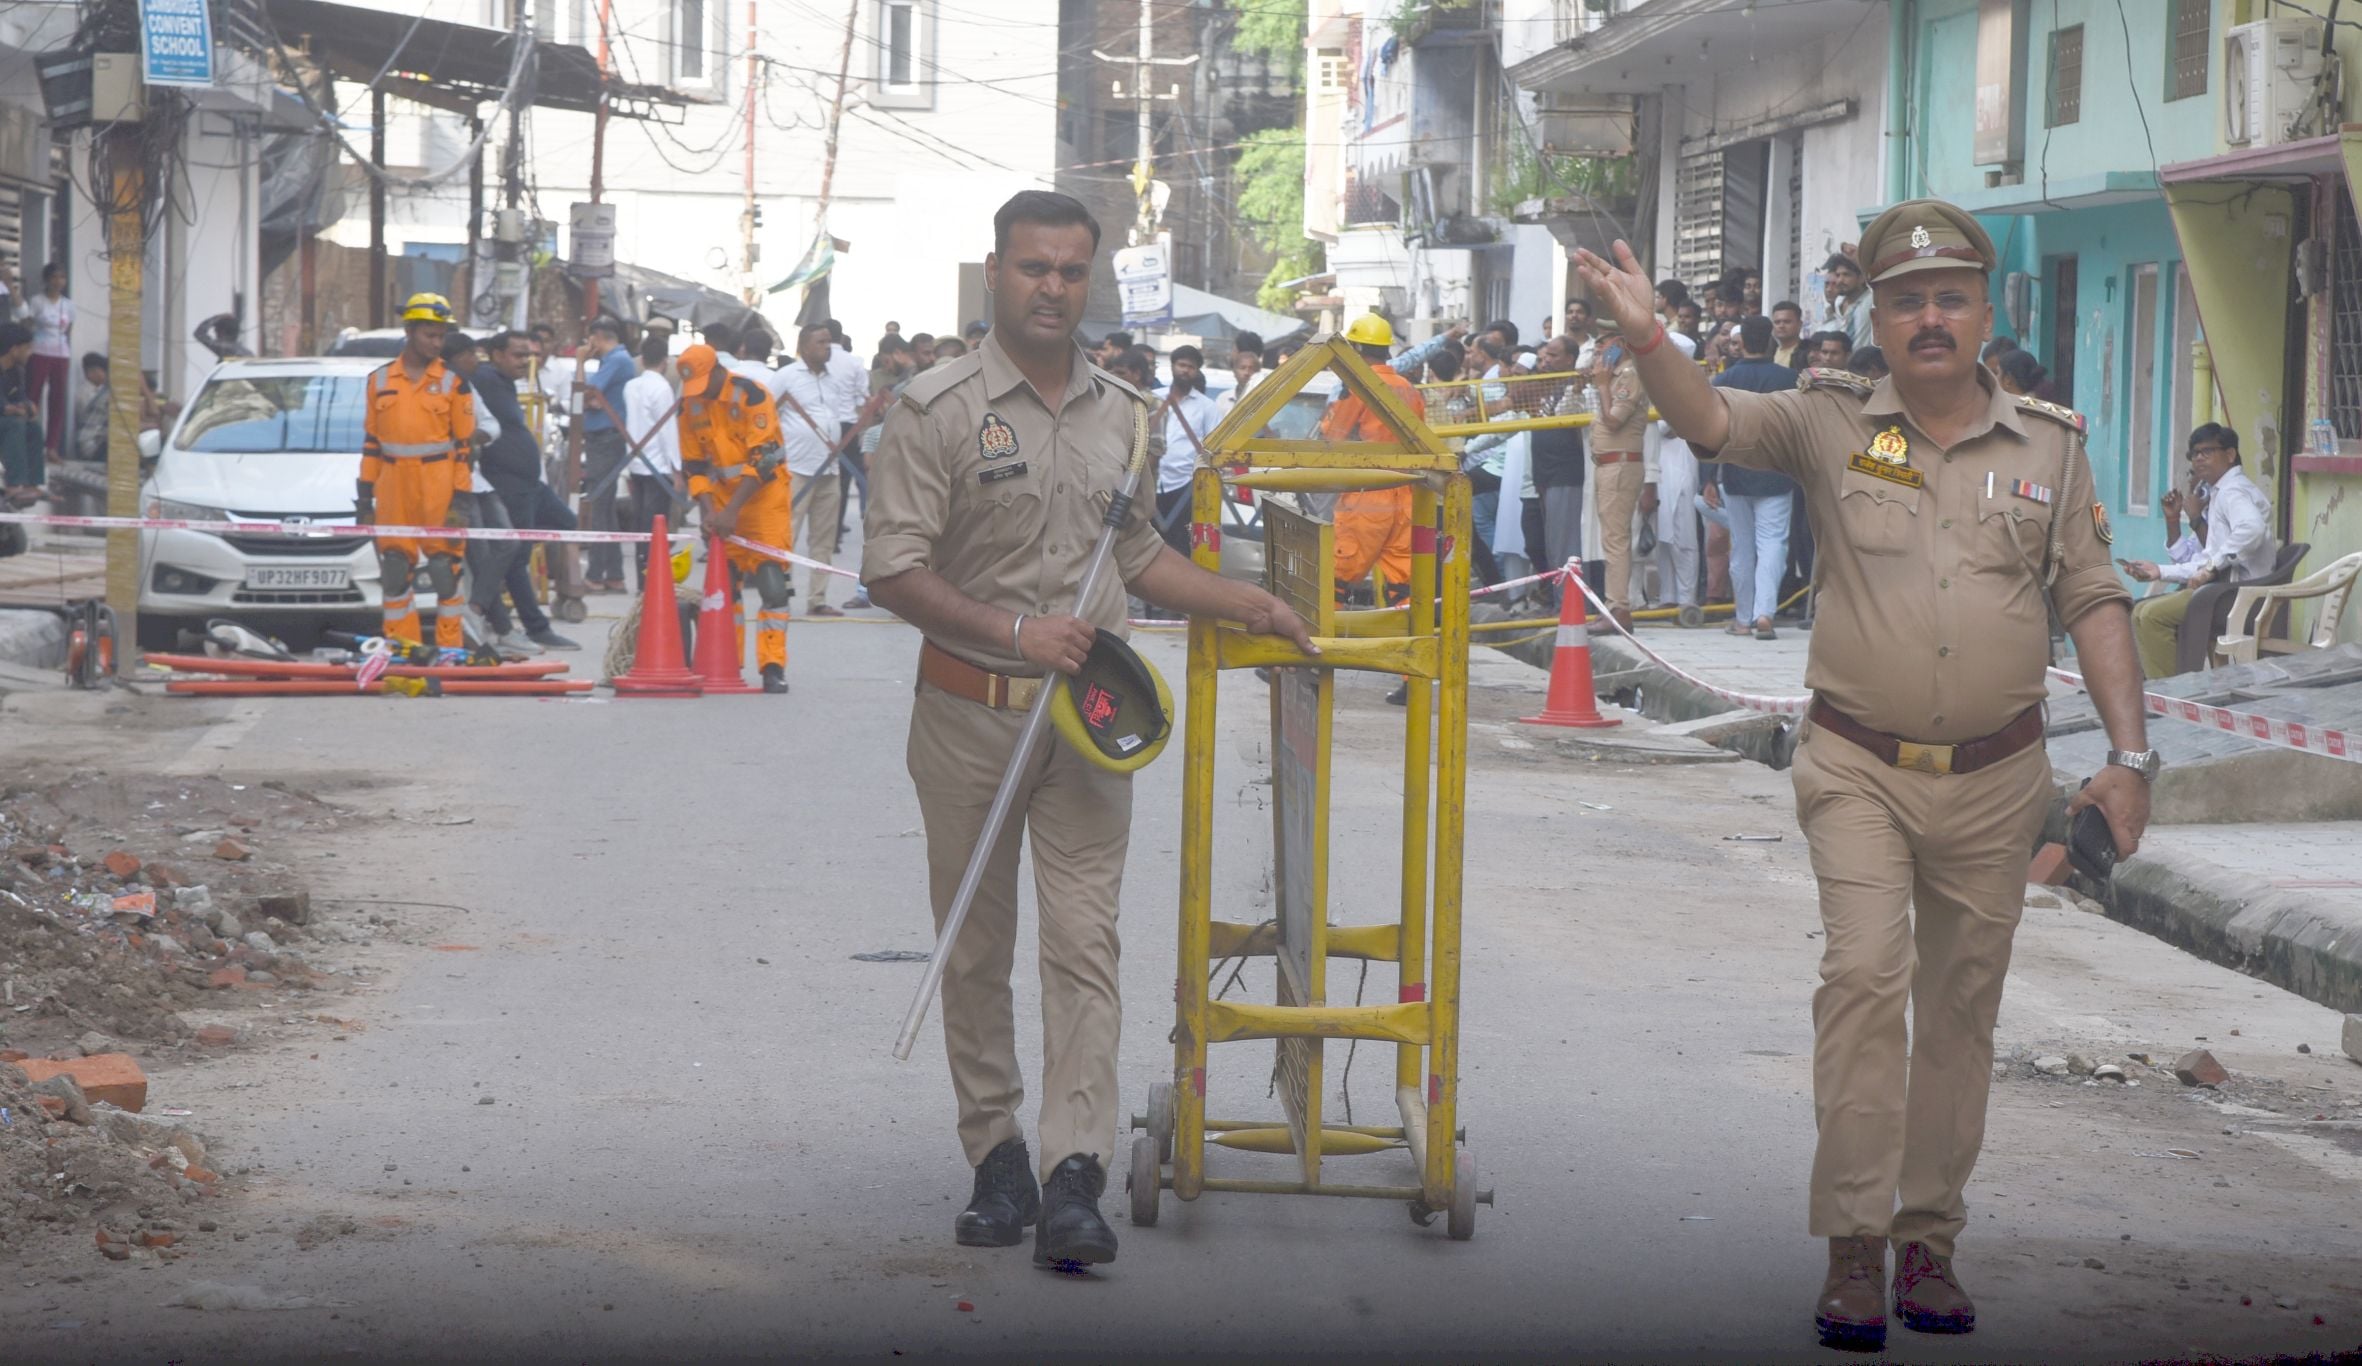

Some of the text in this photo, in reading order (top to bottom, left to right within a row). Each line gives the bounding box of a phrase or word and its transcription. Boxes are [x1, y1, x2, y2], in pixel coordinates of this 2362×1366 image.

[147, 14, 203, 35] CONVENT
[151, 36, 205, 57] SCHOOL
[256, 569, 347, 585] UP32HF9077
